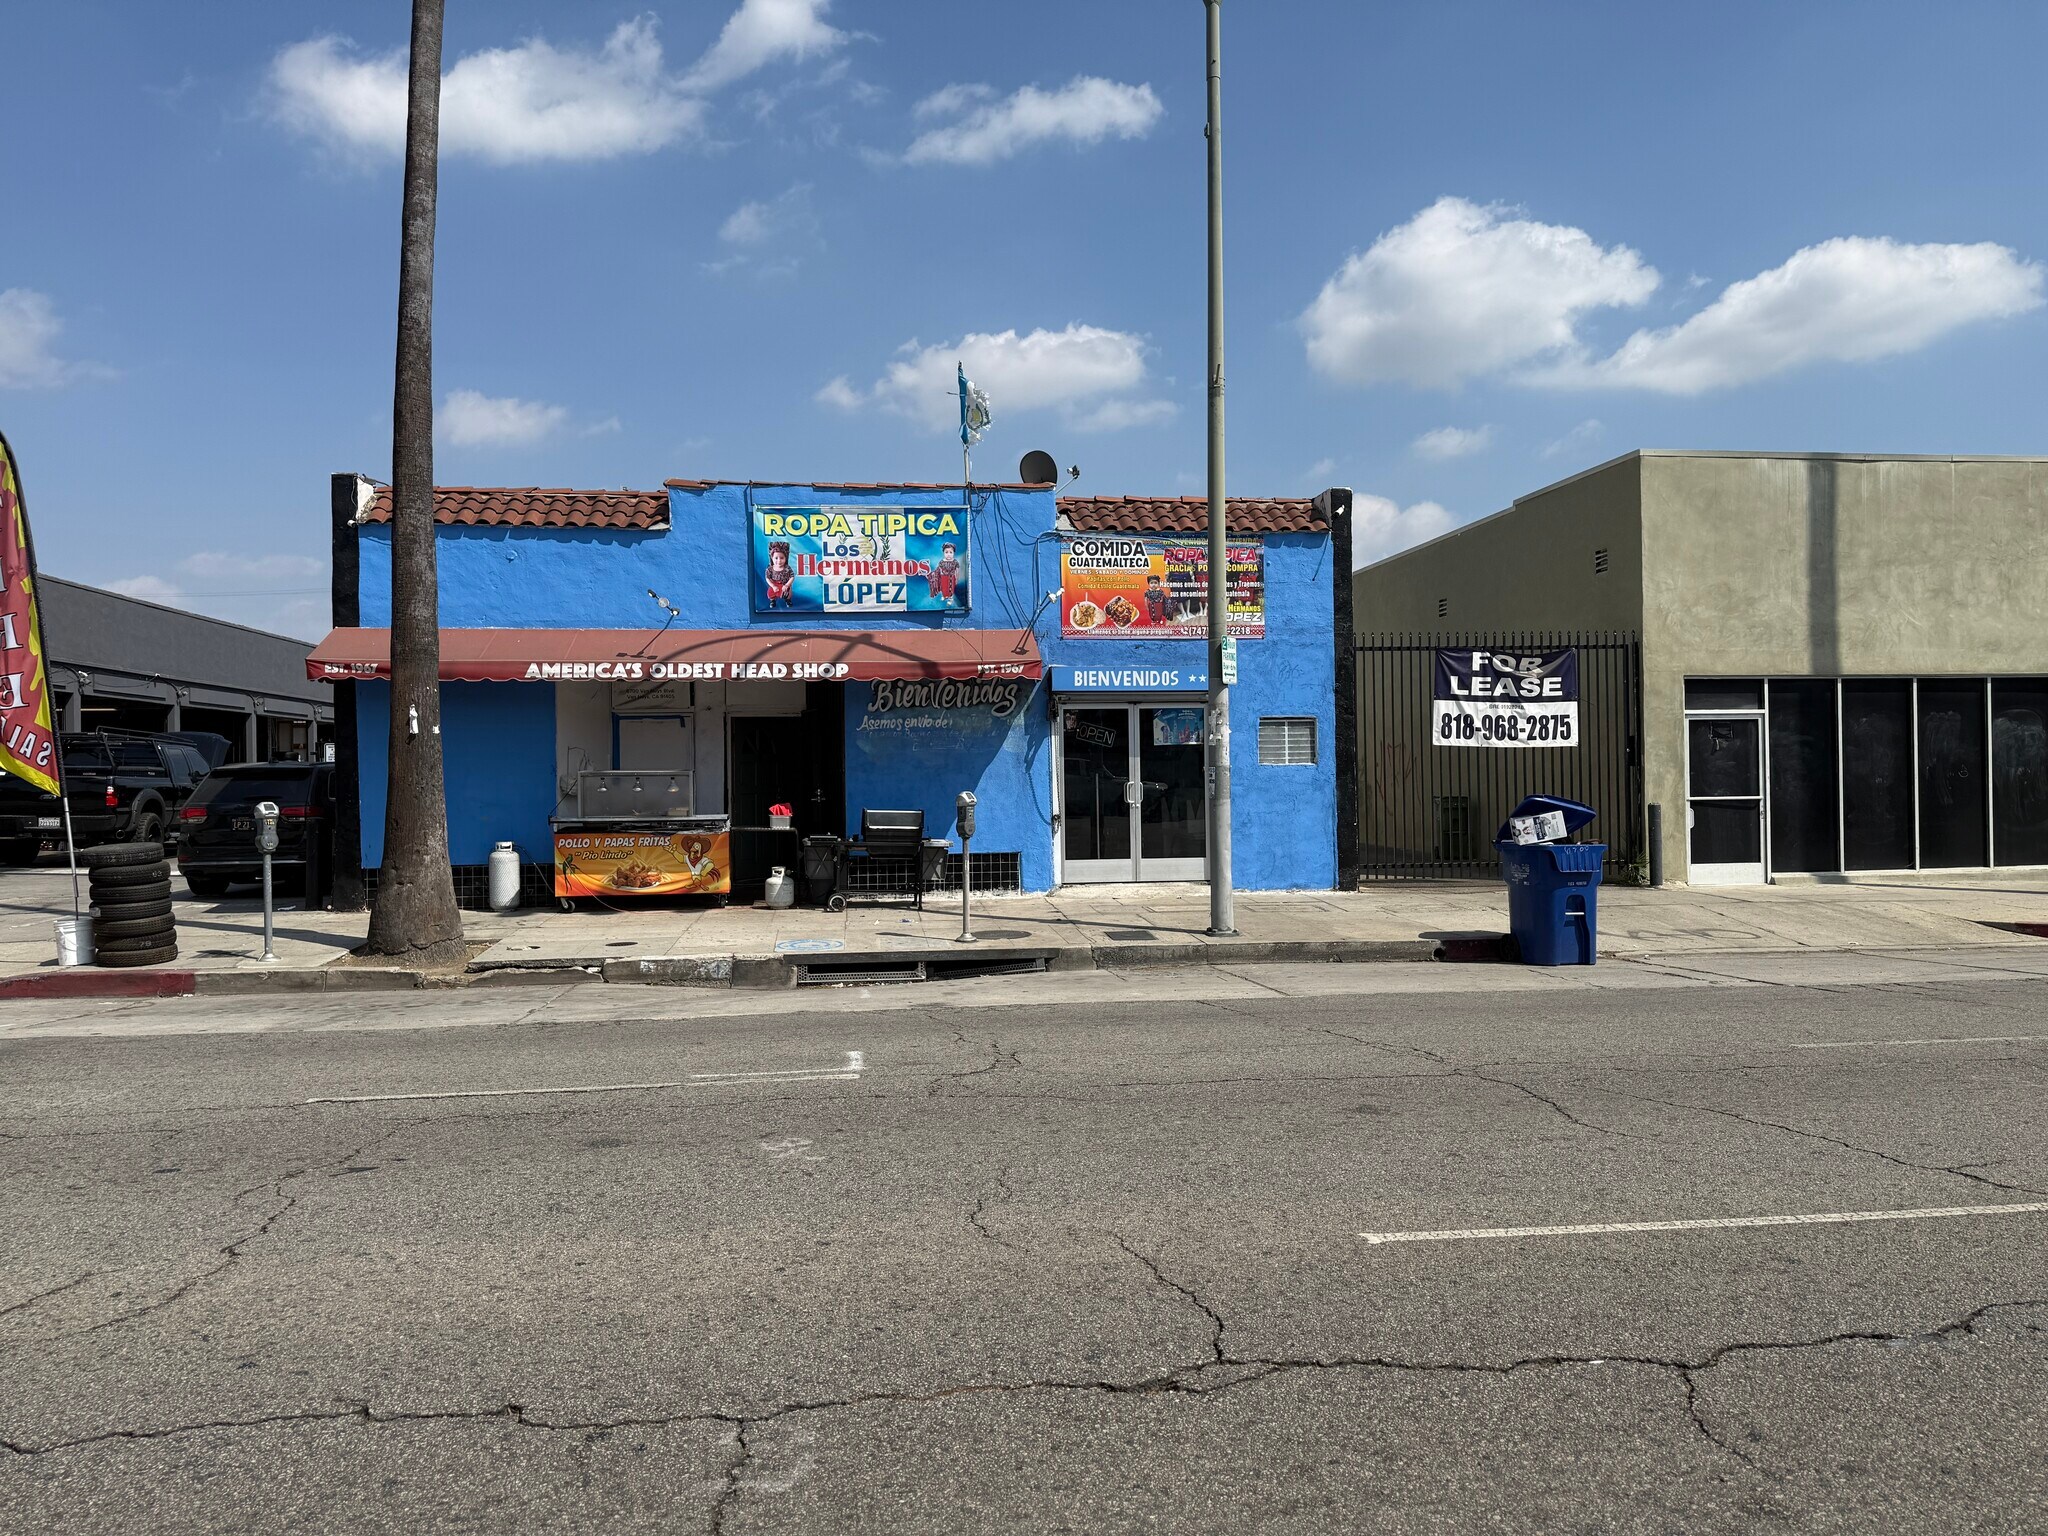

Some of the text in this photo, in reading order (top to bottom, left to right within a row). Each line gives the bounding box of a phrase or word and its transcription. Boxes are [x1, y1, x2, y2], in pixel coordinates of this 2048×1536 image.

[764, 513, 959, 537] ROPA TIPICA
[823, 541, 860, 557] Los
[1072, 541, 1146, 557] COMIDA
[1163, 548, 1257, 562] ROPA PICA
[796, 553, 931, 577] Hermanos
[1069, 557, 1150, 568] GUATEMALTECA
[1164, 563, 1258, 572] GRACIAS PO COMPRA
[824, 578, 906, 605] LÓPEZ
[1226, 612, 1262, 622] OPEZ
[324, 663, 378, 674] EST. 1967
[525, 662, 849, 679] AMERICA'S OLDEST HEAD SHOP
[977, 664, 998, 674] EST.
[1472, 652, 1544, 674] FOR
[1074, 670, 1180, 687] BIENVENIDOS
[1450, 675, 1563, 697] LEASE
[1079, 725, 1114, 744] OPEN
[1440, 712, 1572, 741] 818-968-2875
[558, 836, 671, 848] POLLO Y PAPAS FRITAS
